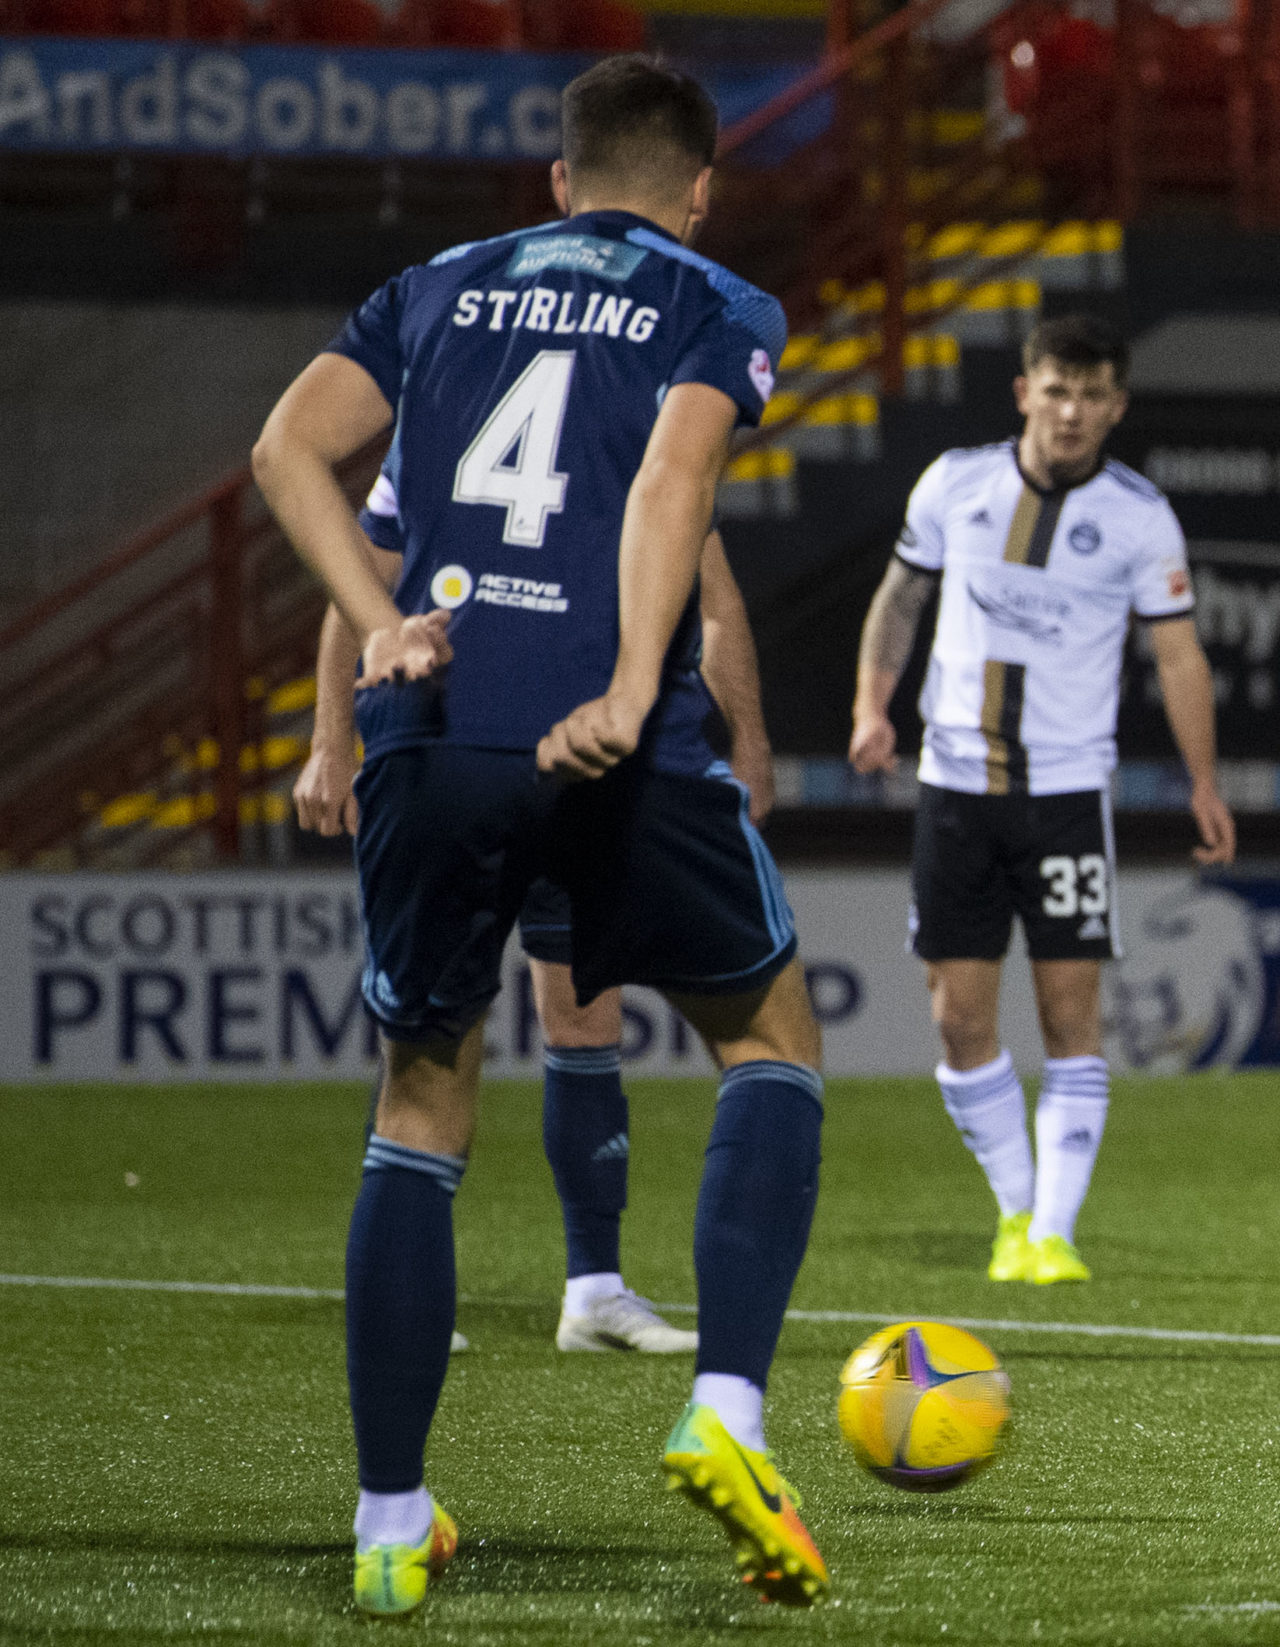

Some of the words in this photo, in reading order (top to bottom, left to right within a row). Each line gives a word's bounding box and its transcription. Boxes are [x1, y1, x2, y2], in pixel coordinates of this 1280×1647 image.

[0, 46, 563, 156] AndSober.c
[452, 286, 661, 343] STIRLING
[452, 349, 577, 548] 4
[474, 588, 570, 614] ACCESS
[478, 573, 563, 598] ACTIVE
[1040, 853, 1106, 918] 33
